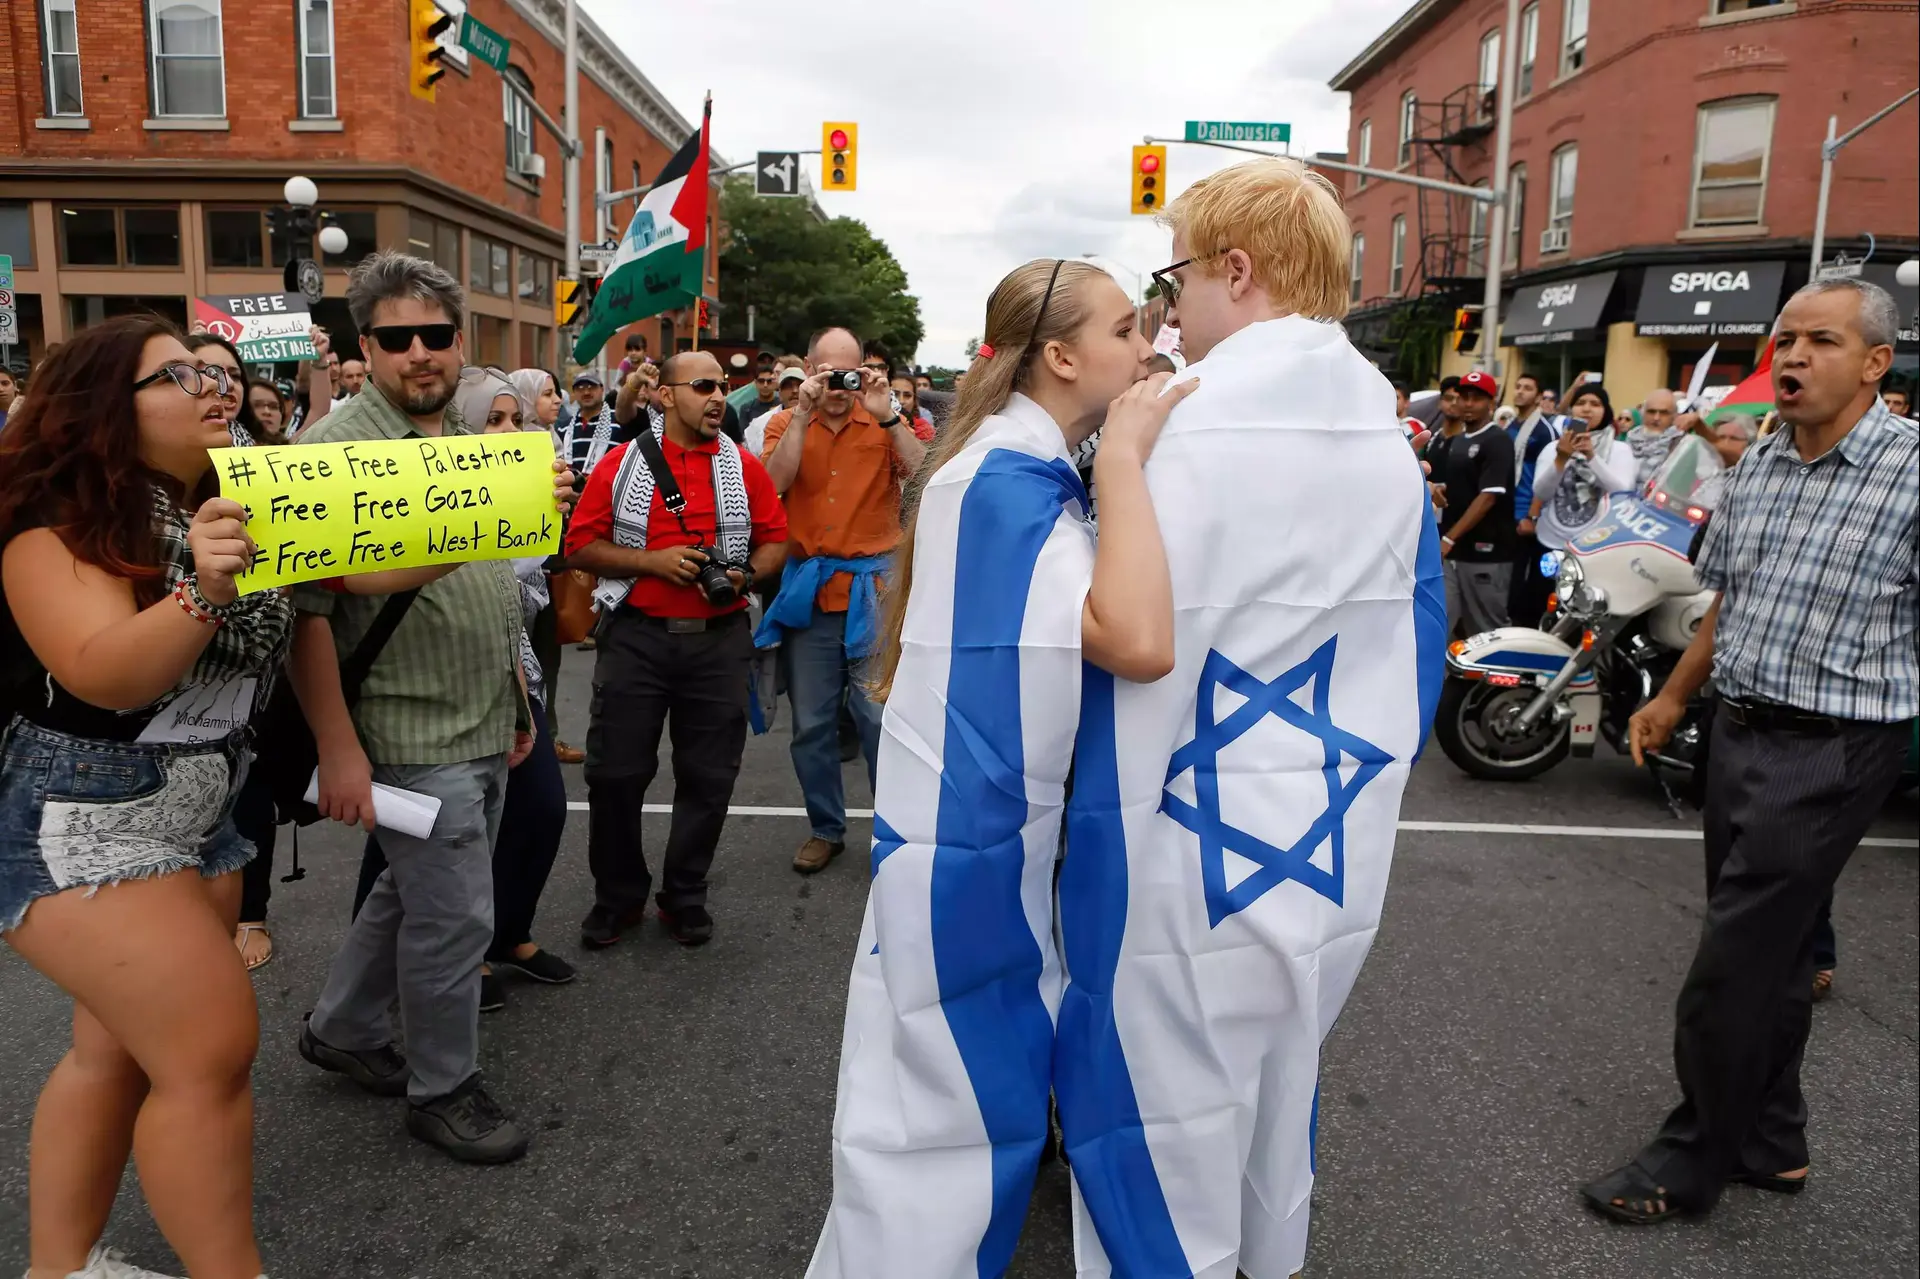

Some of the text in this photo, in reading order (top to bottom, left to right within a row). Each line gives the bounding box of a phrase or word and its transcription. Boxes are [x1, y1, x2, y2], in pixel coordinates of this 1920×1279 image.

[468, 21, 503, 67] Murray
[1197, 120, 1280, 141] Dalhousie
[1537, 283, 1578, 309] SPIGA
[1669, 270, 1751, 294] SPIGA
[228, 295, 287, 314] FREE
[1639, 323, 1766, 335] RESTAURANT LOUNGE
[264, 454, 333, 484] Free
[343, 445, 399, 479] Free
[419, 442, 525, 477] Palestine
[270, 494, 329, 524] Free
[353, 491, 410, 525] Free
[425, 484, 493, 513] Gaza
[1612, 499, 1670, 540] POLICE
[276, 540, 340, 579] Free
[348, 530, 406, 566] Free
[427, 520, 488, 555] West
[497, 513, 553, 549] Bank
